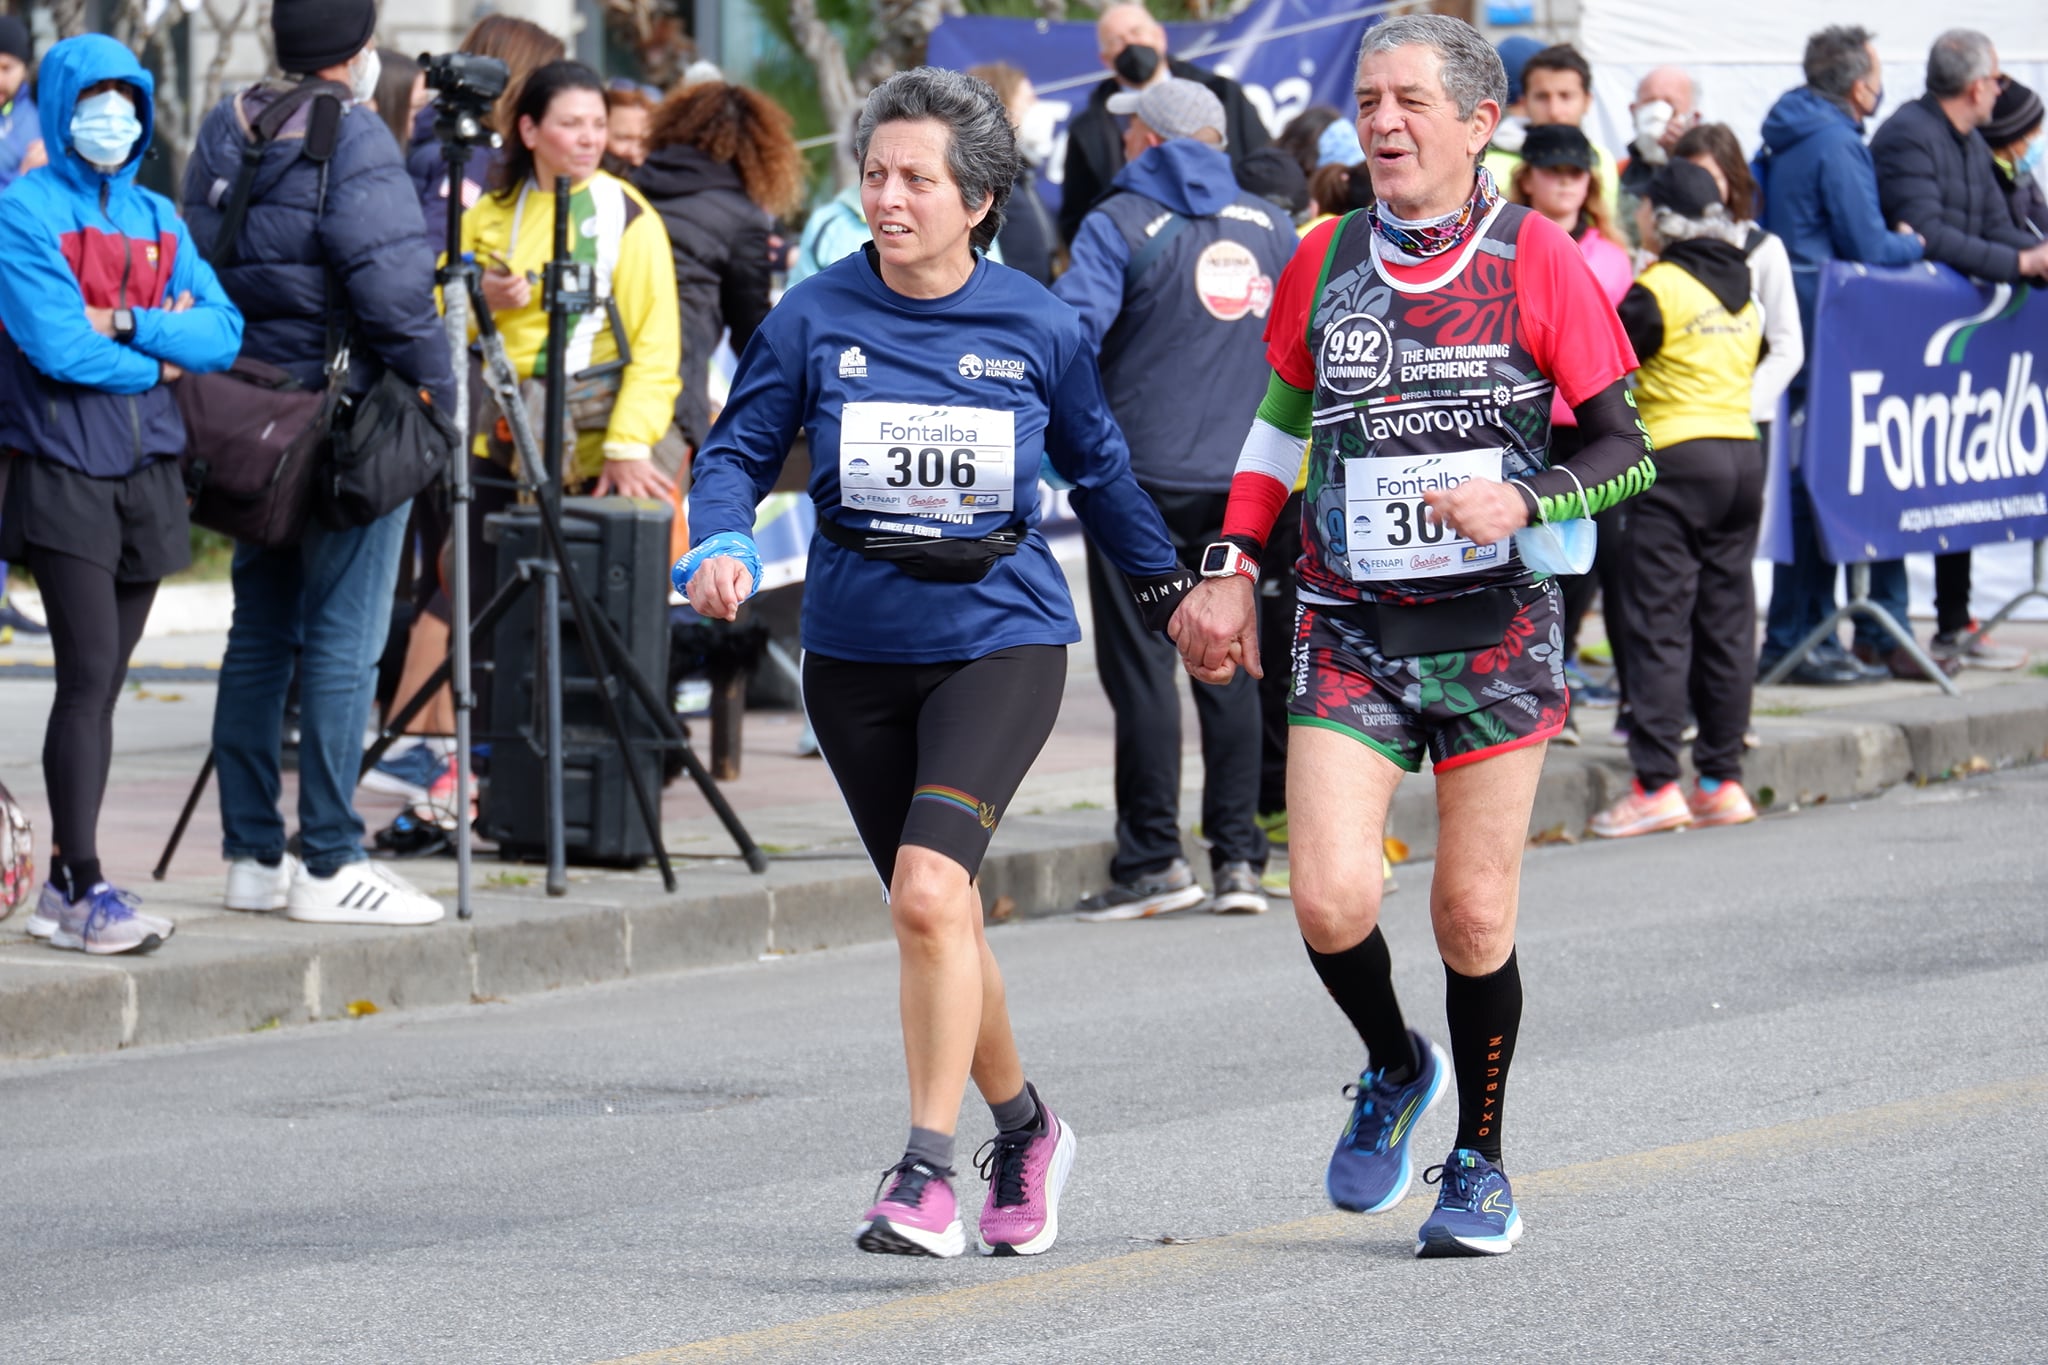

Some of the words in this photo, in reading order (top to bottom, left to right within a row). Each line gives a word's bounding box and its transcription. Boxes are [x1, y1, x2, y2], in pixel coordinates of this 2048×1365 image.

[1402, 350, 1424, 364] THE
[1425, 348, 1453, 362] NEW
[1457, 344, 1509, 359] RUNNING
[985, 359, 1025, 370] NAPOLI
[985, 369, 1024, 380] RUNNING
[1327, 366, 1377, 379] RUNNING
[1401, 361, 1488, 383] EXPERIENCE
[1402, 391, 1431, 400] OFFICIAL
[1432, 390, 1451, 398] TEAM
[1848, 351, 2048, 495] Fontalb
[880, 422, 977, 442] Fontalba
[886, 447, 976, 488] 306
[867, 495, 900, 504] FENAPI
[962, 495, 998, 505] ARD
[1464, 545, 1497, 561] ARD
[1371, 558, 1403, 568] FENAPI
[1351, 704, 1368, 714] THE
[1368, 703, 1388, 714] NEW
[1479, 1035, 1503, 1136] OXYBURN
